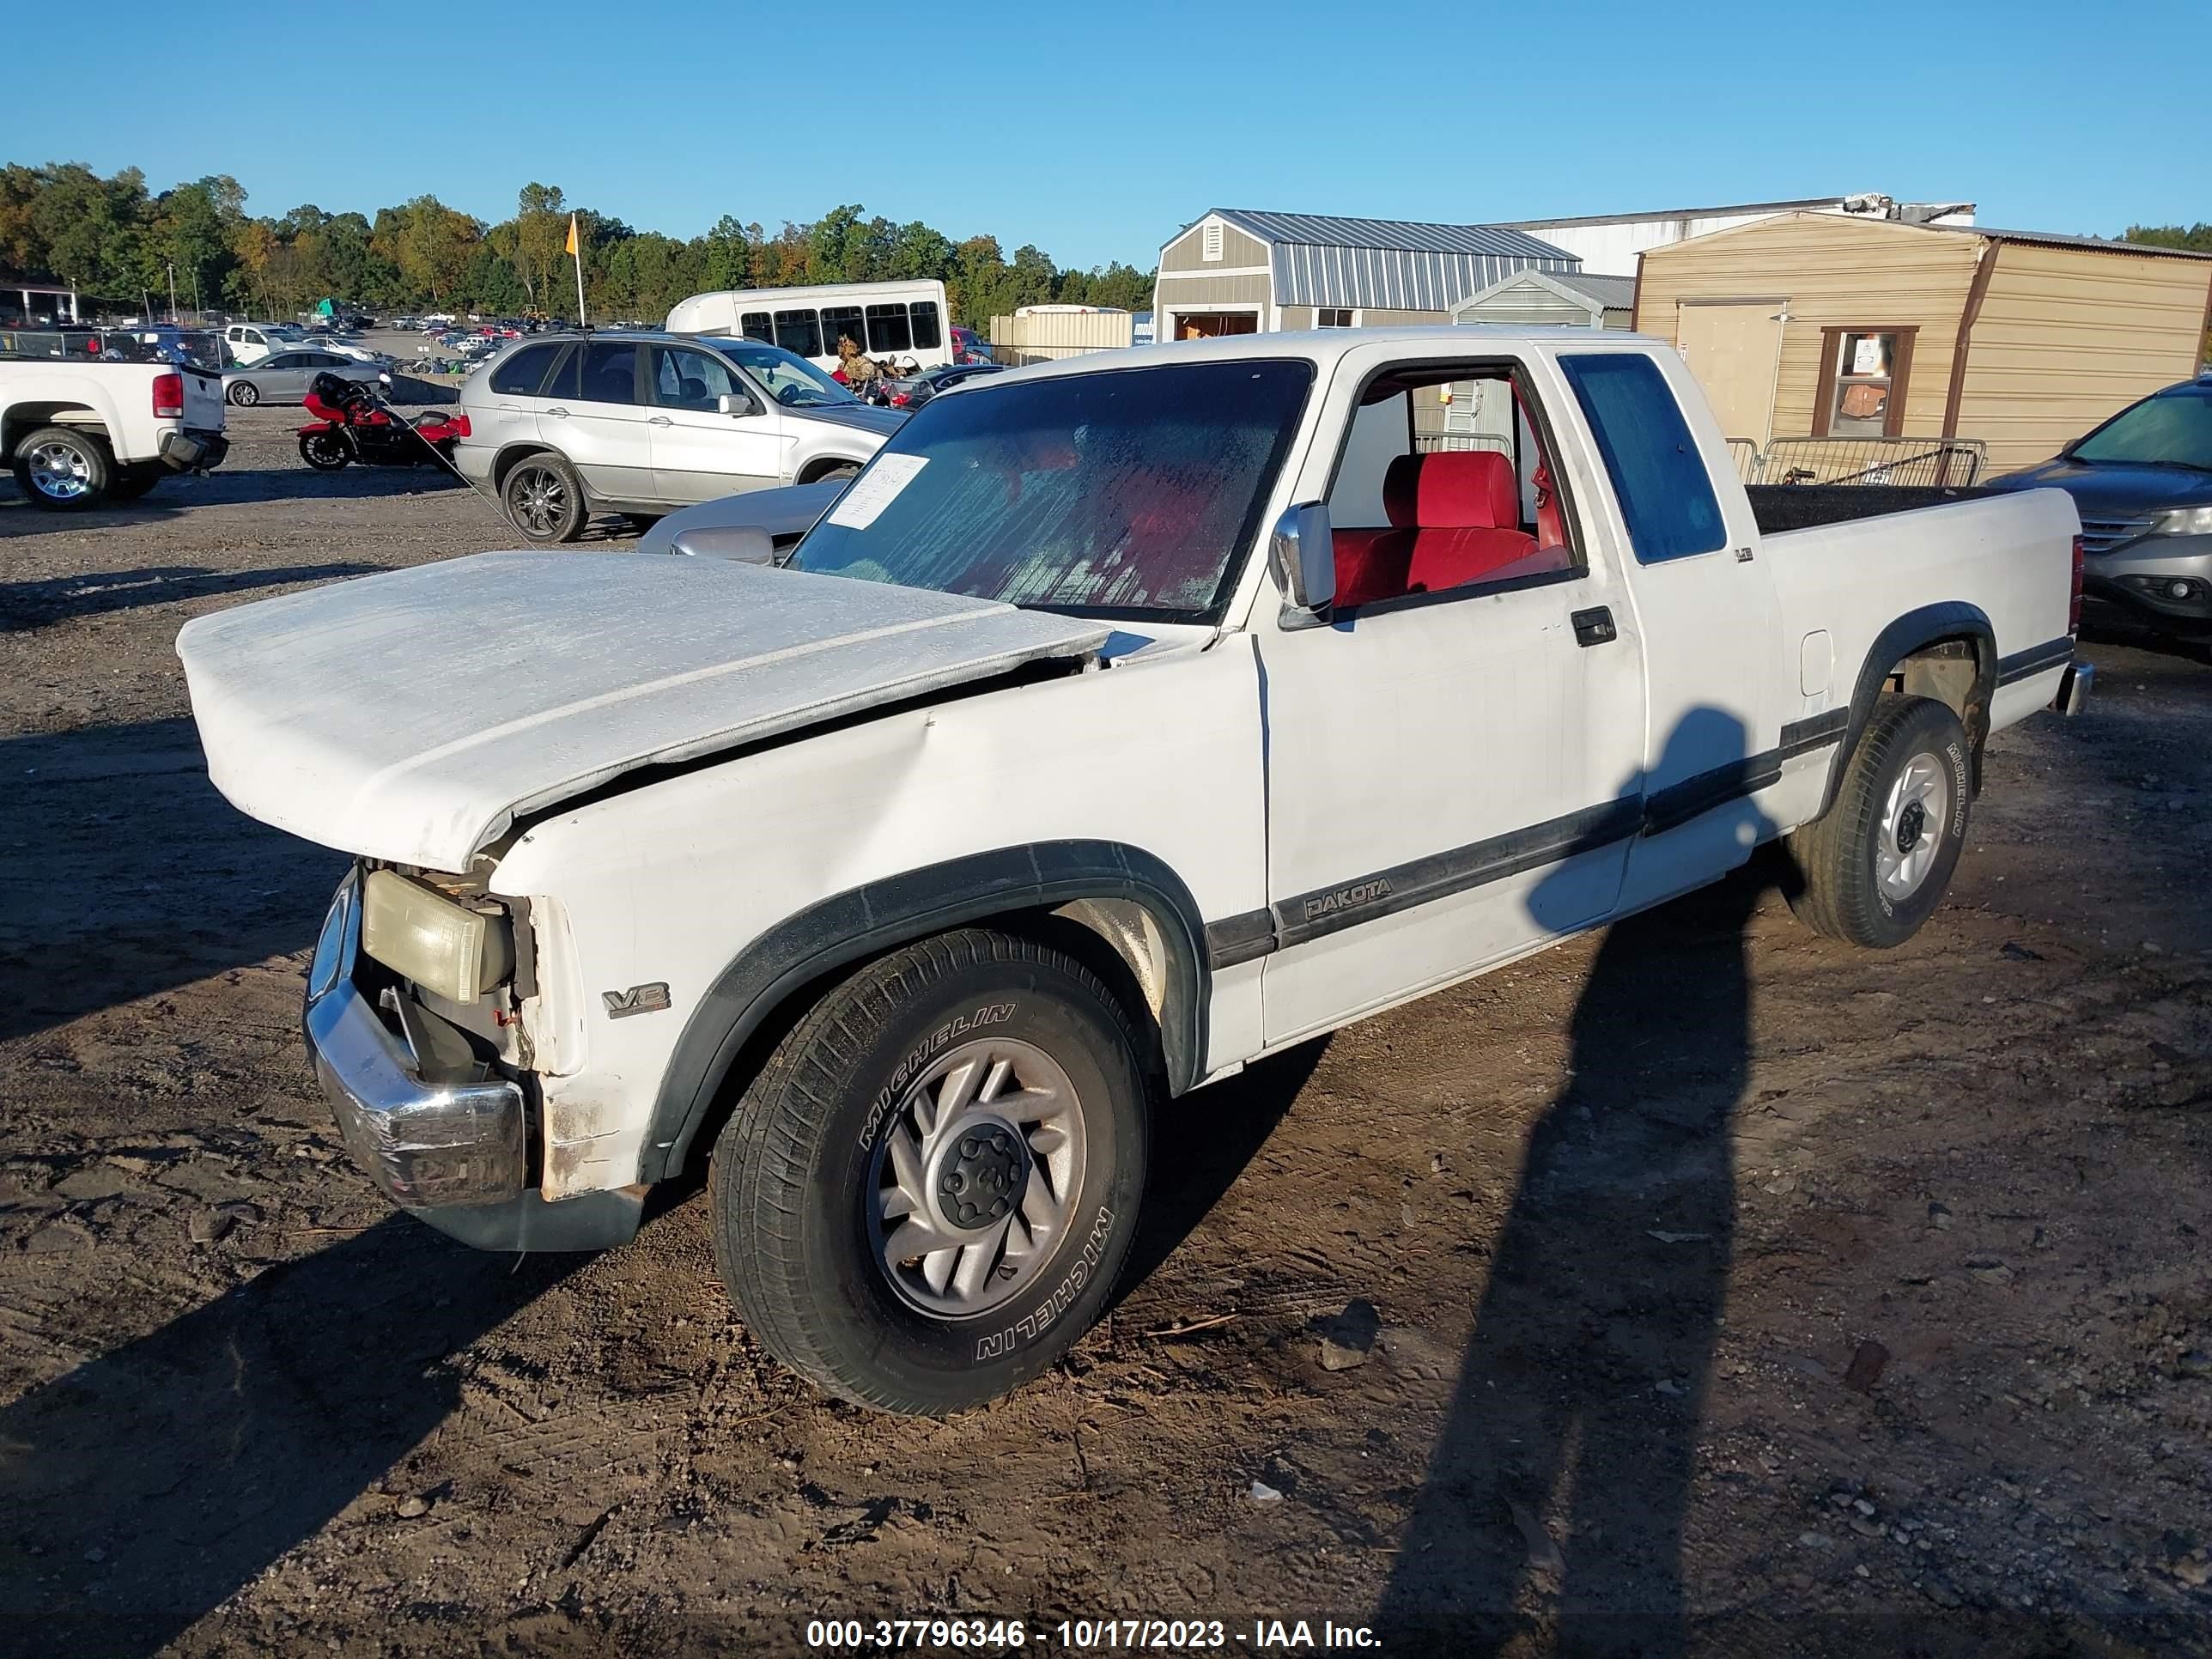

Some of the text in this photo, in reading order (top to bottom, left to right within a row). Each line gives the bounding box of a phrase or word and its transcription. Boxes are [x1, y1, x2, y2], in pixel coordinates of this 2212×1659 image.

[1947, 743, 1966, 837] MICHELIN
[1304, 878, 1392, 919] DAKOTA
[602, 982, 670, 1011] V8
[859, 1003, 1018, 1152] MICHELIN
[976, 1206, 1115, 1360] MICHELIN
